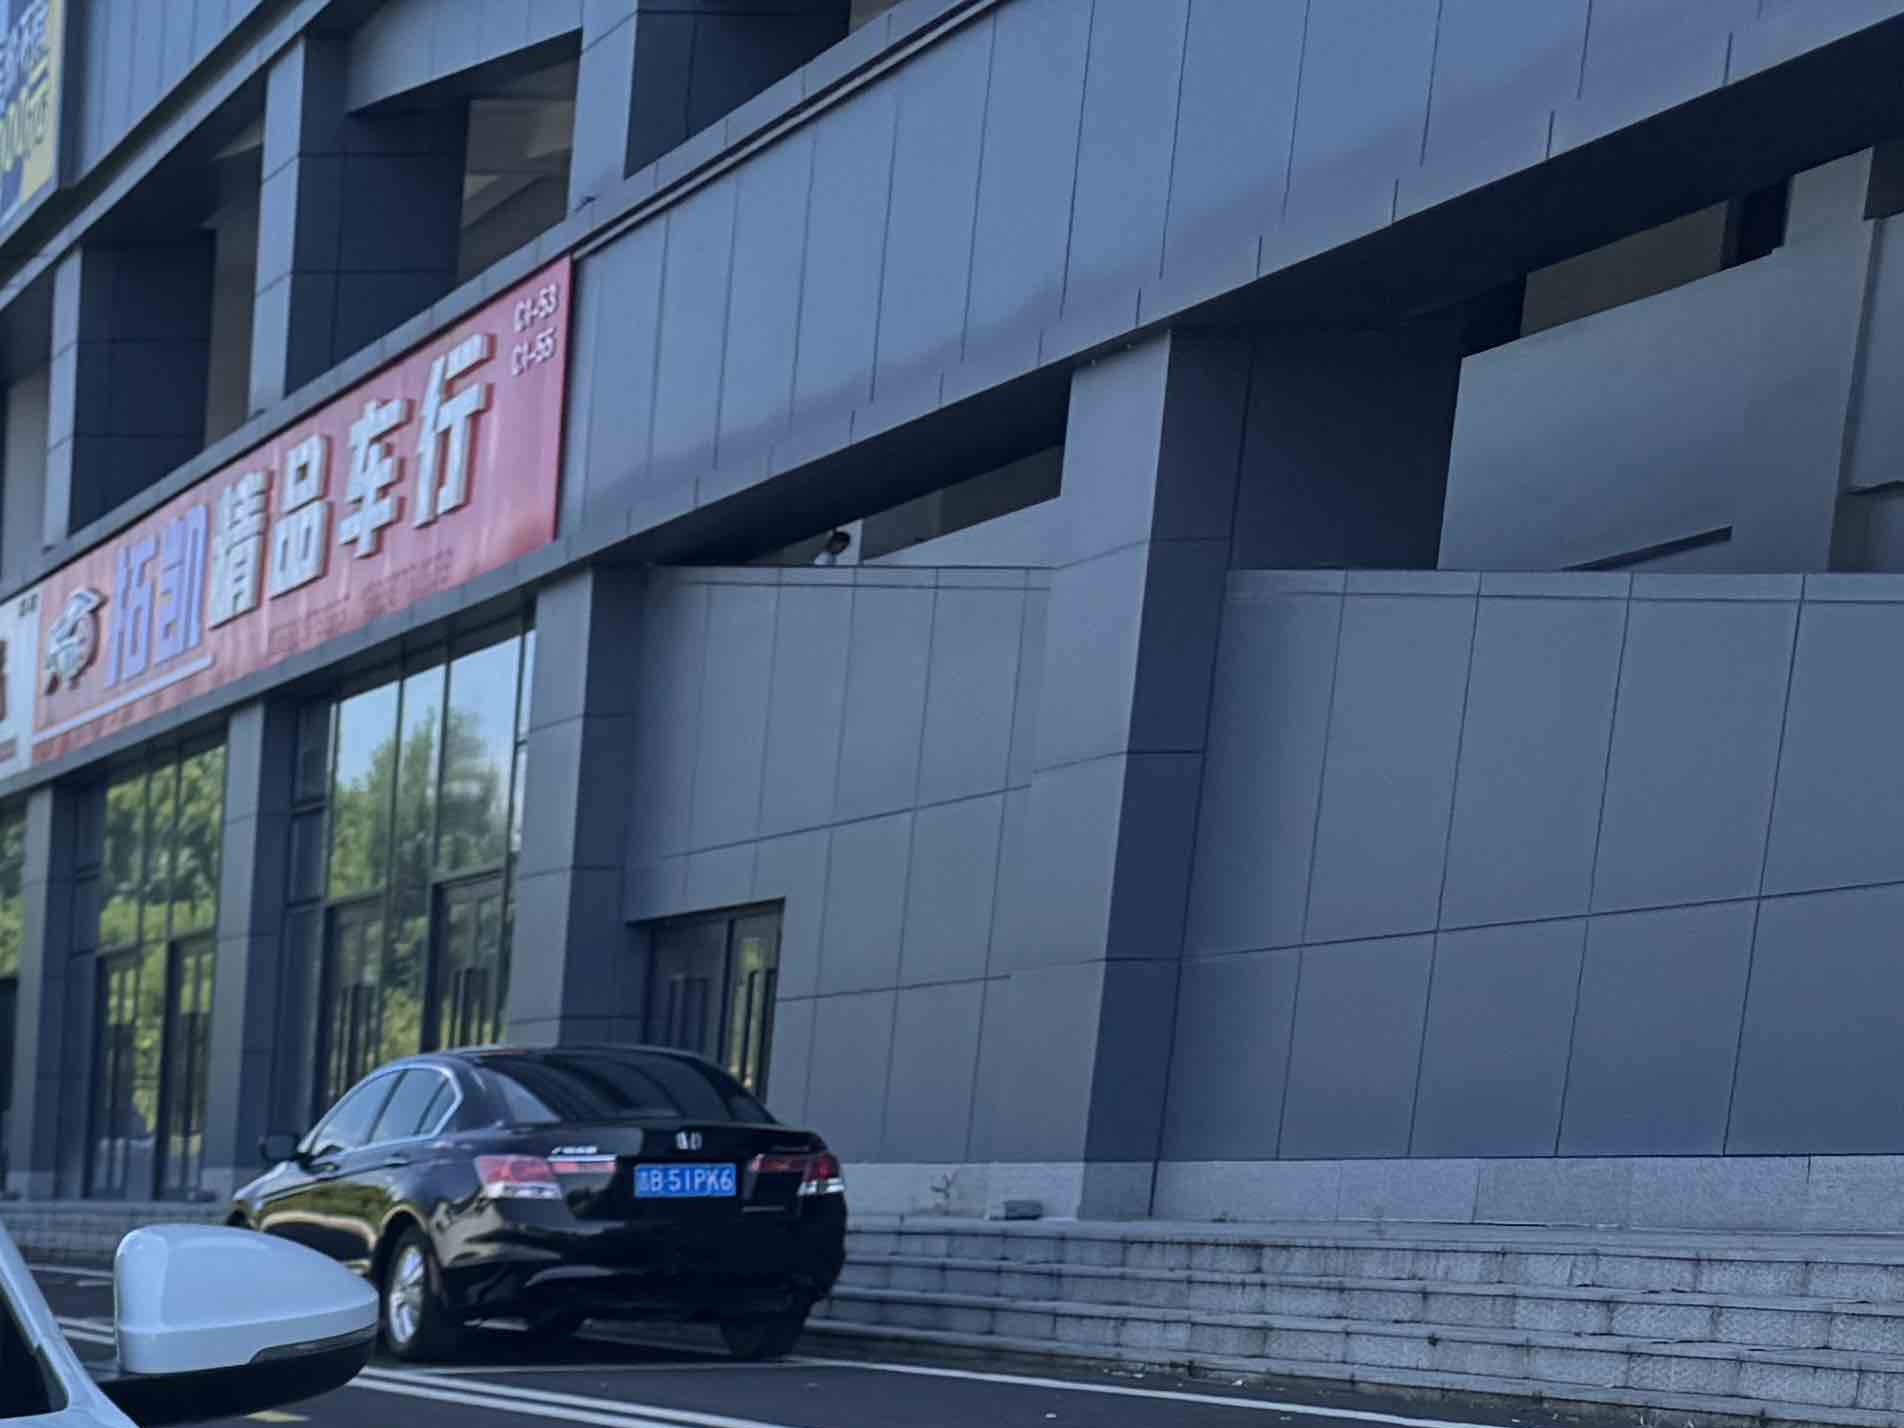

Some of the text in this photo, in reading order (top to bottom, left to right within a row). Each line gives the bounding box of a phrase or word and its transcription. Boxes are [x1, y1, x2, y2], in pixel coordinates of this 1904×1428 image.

[514, 283, 560, 332] C1-53
[512, 327, 556, 375] C1-55
[104, 333, 495, 690] 拓凯精品车行
